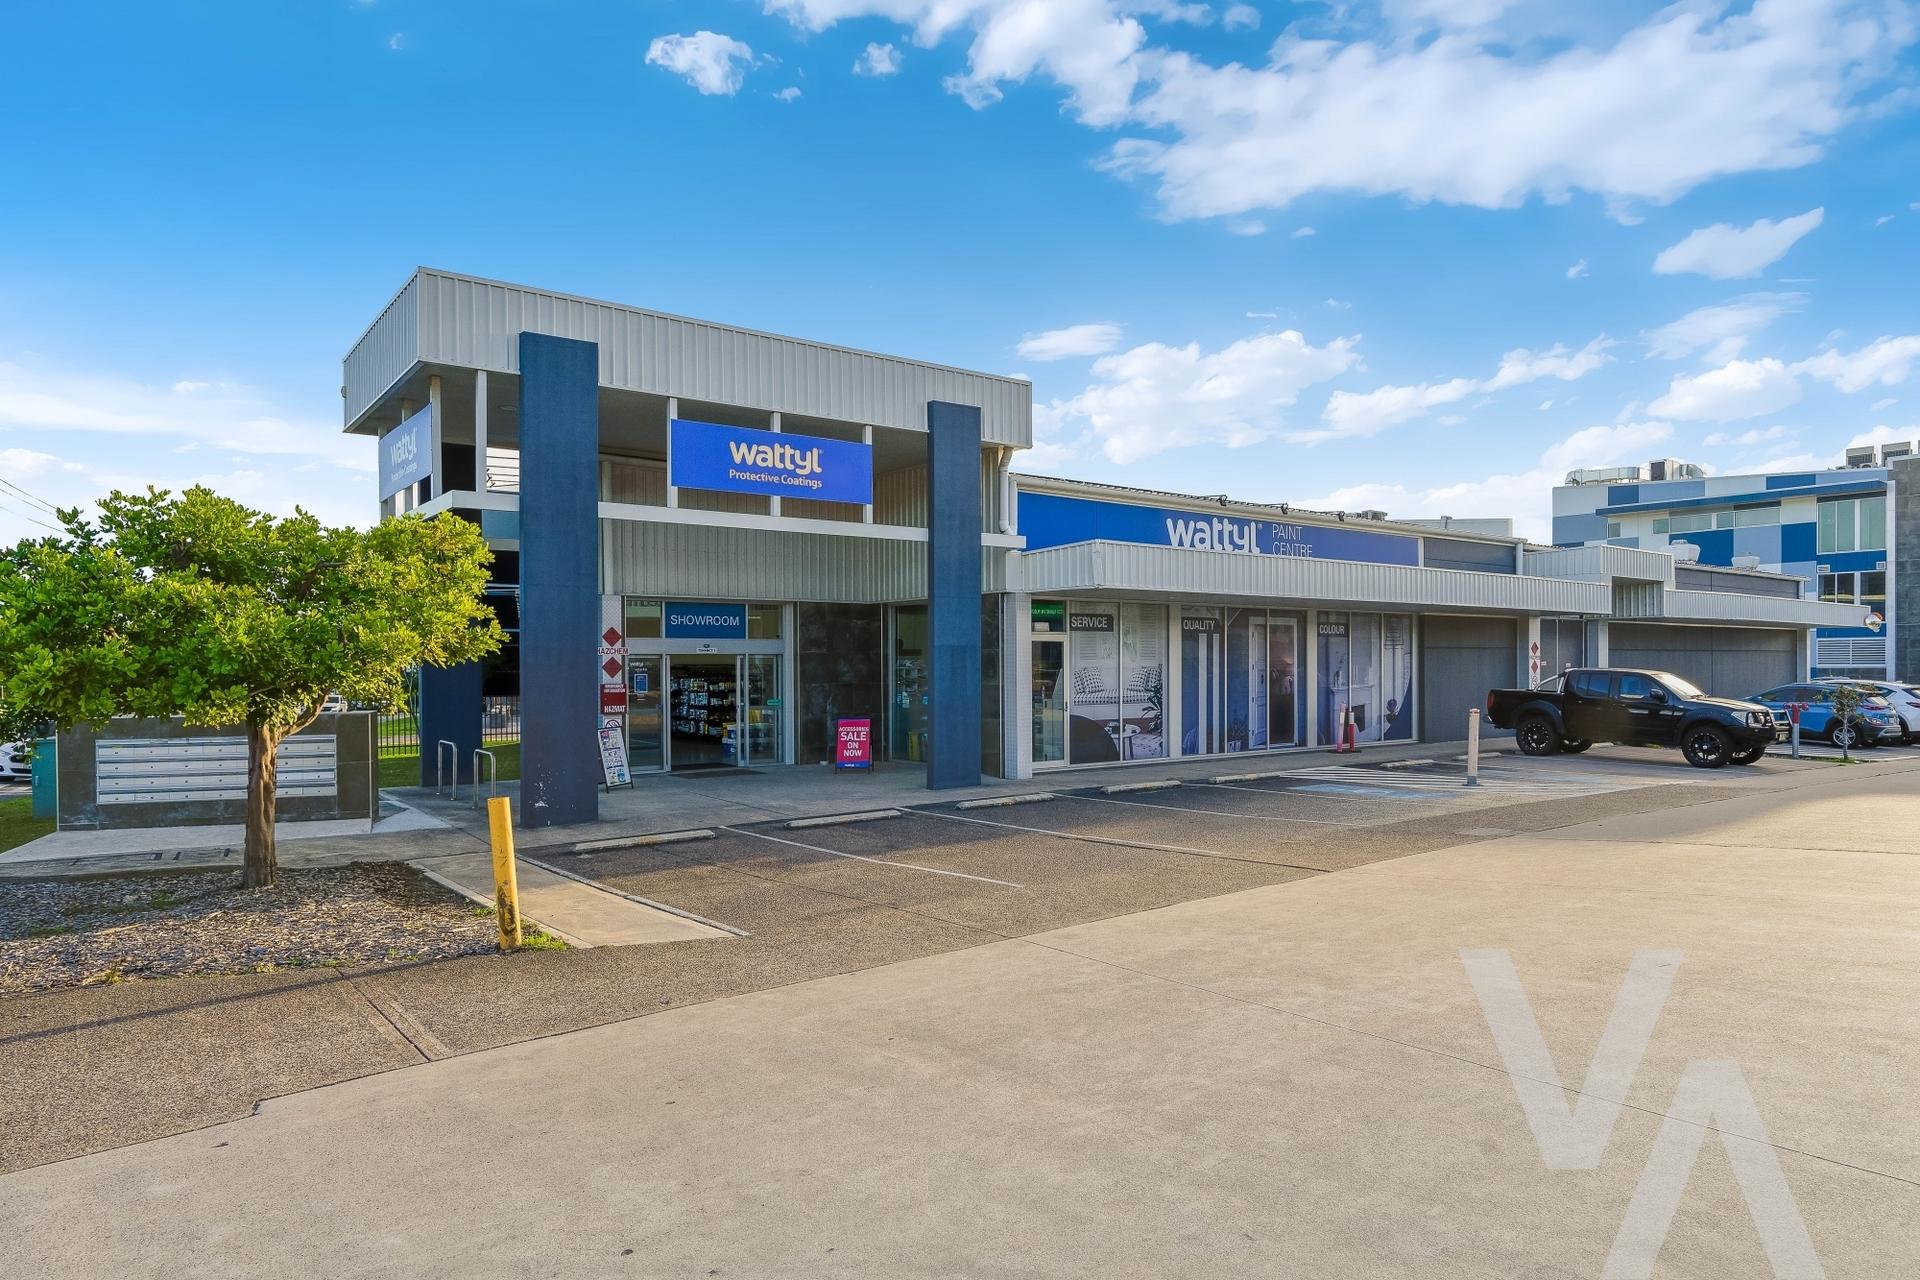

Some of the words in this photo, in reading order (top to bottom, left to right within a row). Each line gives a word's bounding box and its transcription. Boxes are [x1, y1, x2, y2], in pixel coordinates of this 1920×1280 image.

[729, 441, 822, 475] wattyl
[729, 469, 780, 484] Protective
[781, 474, 823, 490] Coatings
[1166, 517, 1260, 555] wattyl
[1272, 523, 1303, 541] PAINT
[1272, 541, 1313, 558] CENTRE
[670, 615, 740, 626] SHOWROOM
[1071, 616, 1108, 628] SERVICE
[1183, 619, 1216, 631] QUALITY
[1319, 624, 1345, 635] COLOUR
[604, 705, 626, 713] HAZMAT
[840, 732, 866, 740] SALE
